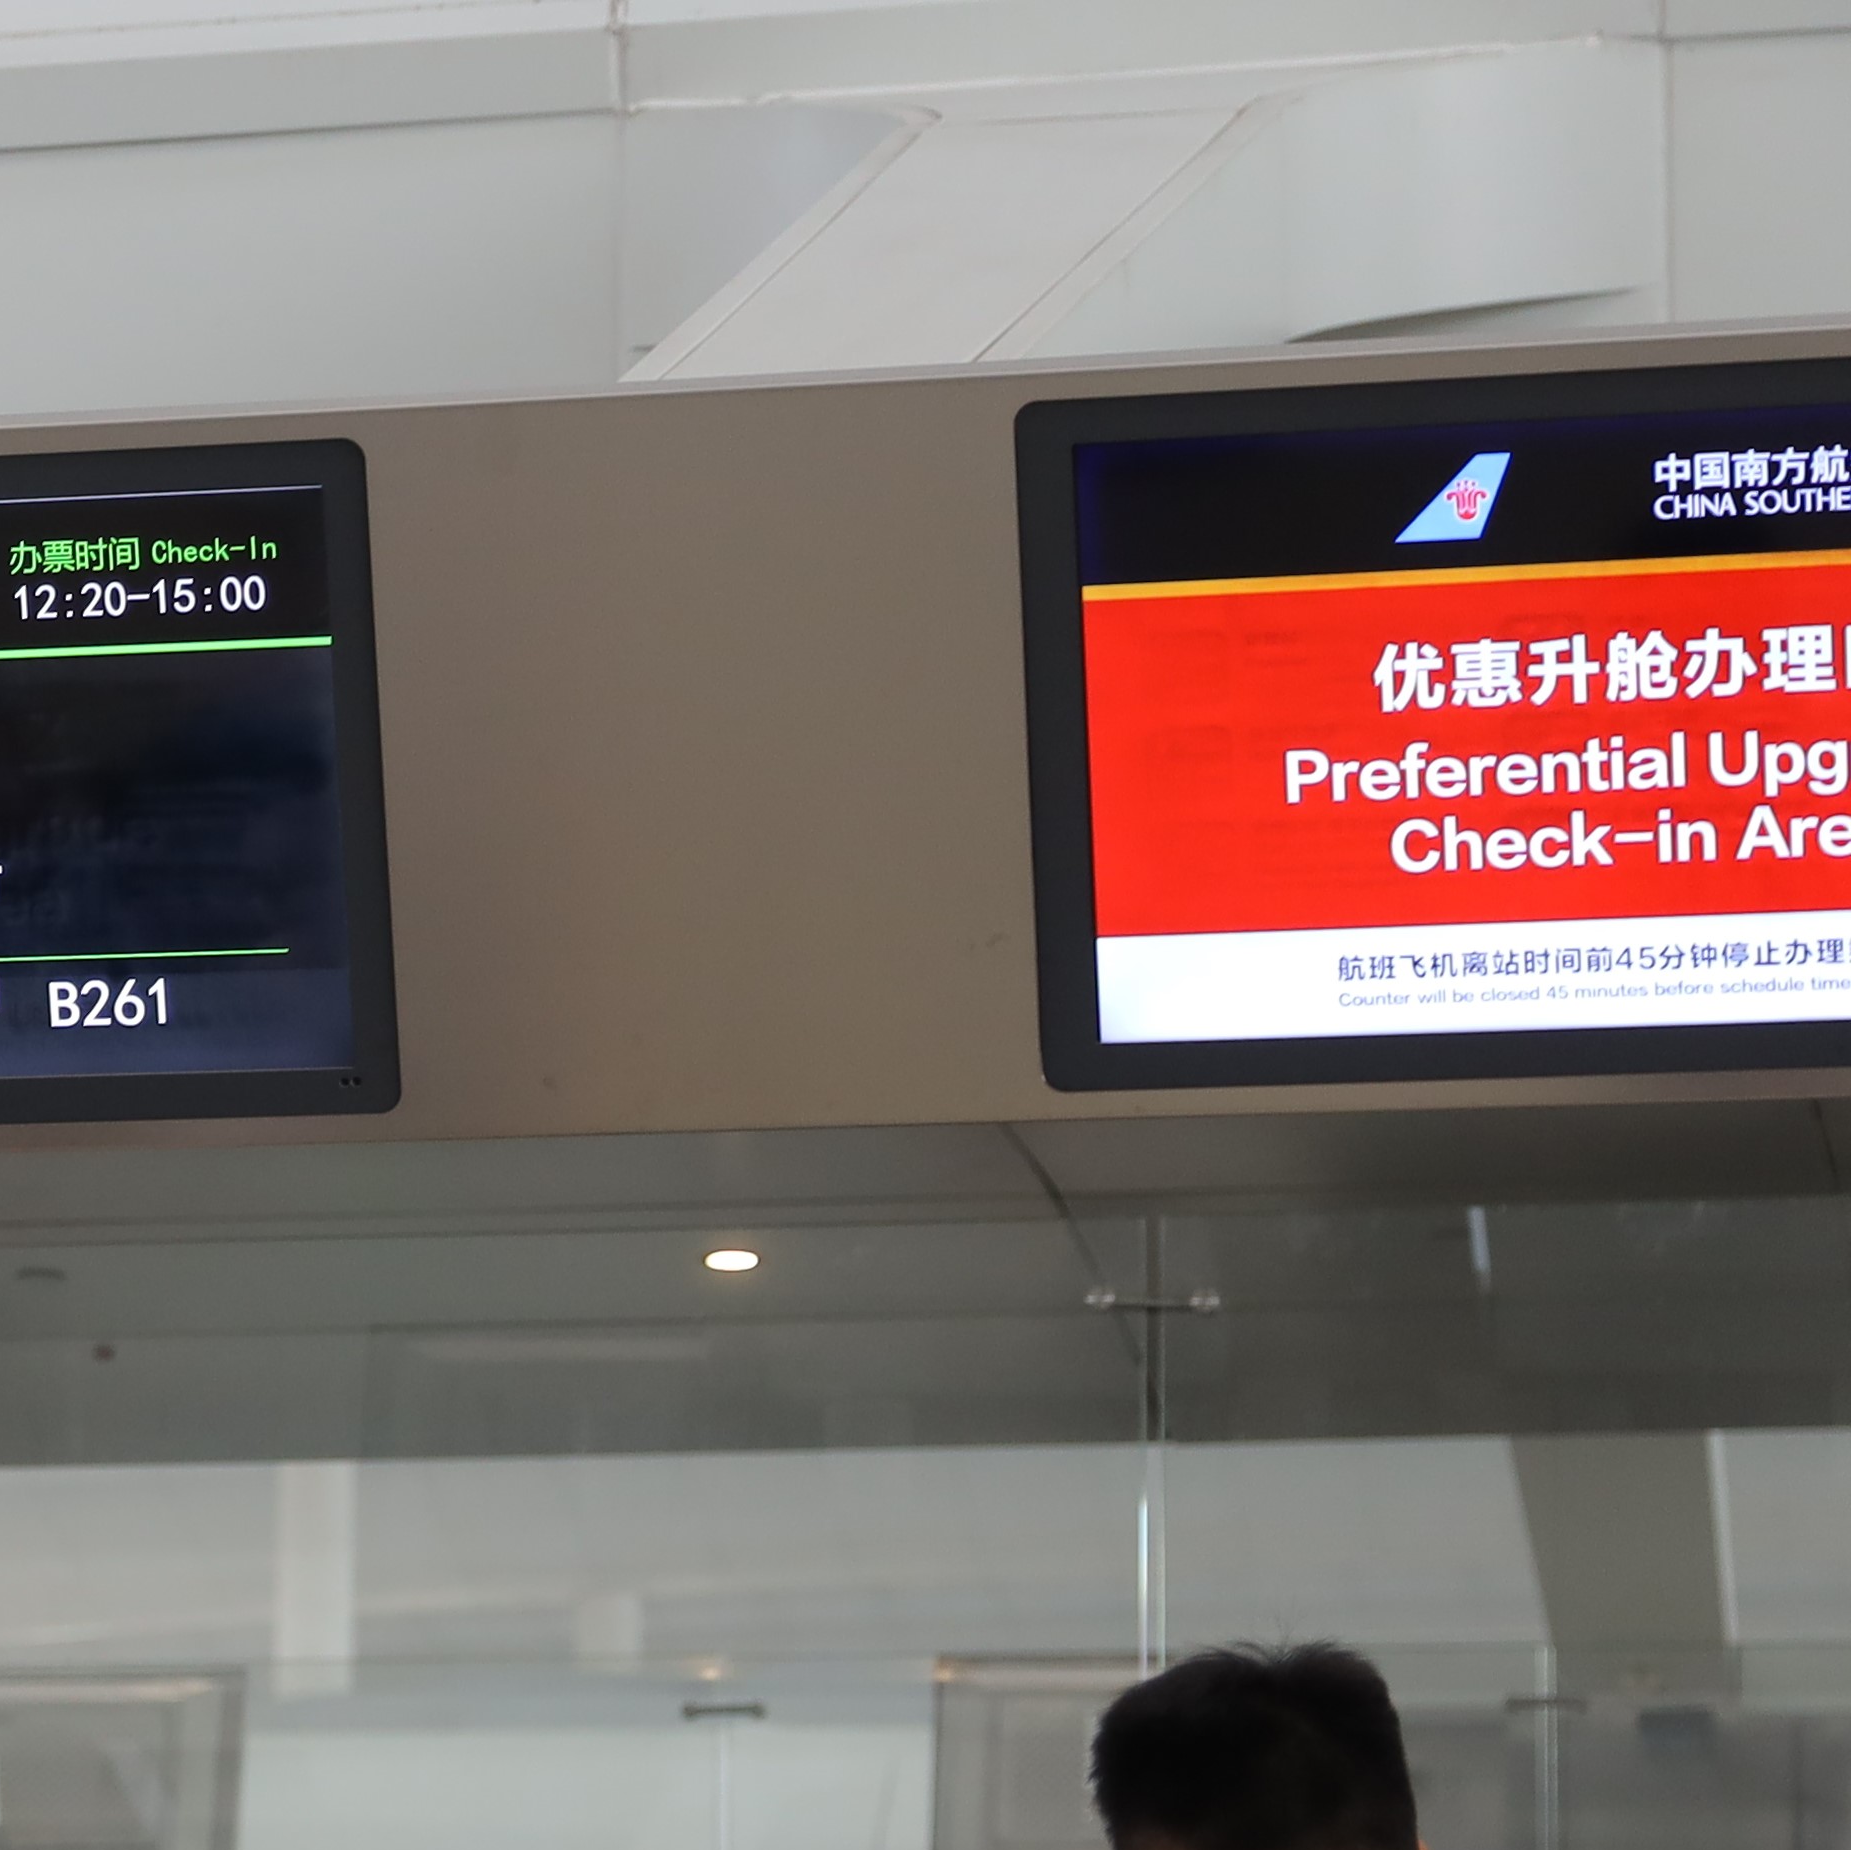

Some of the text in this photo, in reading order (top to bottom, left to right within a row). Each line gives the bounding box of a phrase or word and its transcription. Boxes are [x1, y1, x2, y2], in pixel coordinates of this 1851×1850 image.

[1653, 485, 1851, 521] CHINA SOUTHE
[9, 535, 139, 576] 办票时间
[12, 575, 266, 622] 12:20-15:00
[1372, 624, 1851, 714] 优惠升舱办理
[1286, 733, 1685, 804] Preferential
[1391, 808, 1716, 873] Check-in
[1338, 938, 1851, 981] 航班飞机离站时间前45分钟停止办理
[49, 979, 168, 1030] B261
[1418, 989, 1446, 1004] will
[1453, 988, 1474, 1003] be
[1481, 987, 1539, 1001] closed
[1547, 985, 1569, 999] 45
[1575, 983, 1647, 998] minutes
[1655, 981, 1713, 996] before
[1721, 977, 1804, 993] schedule
